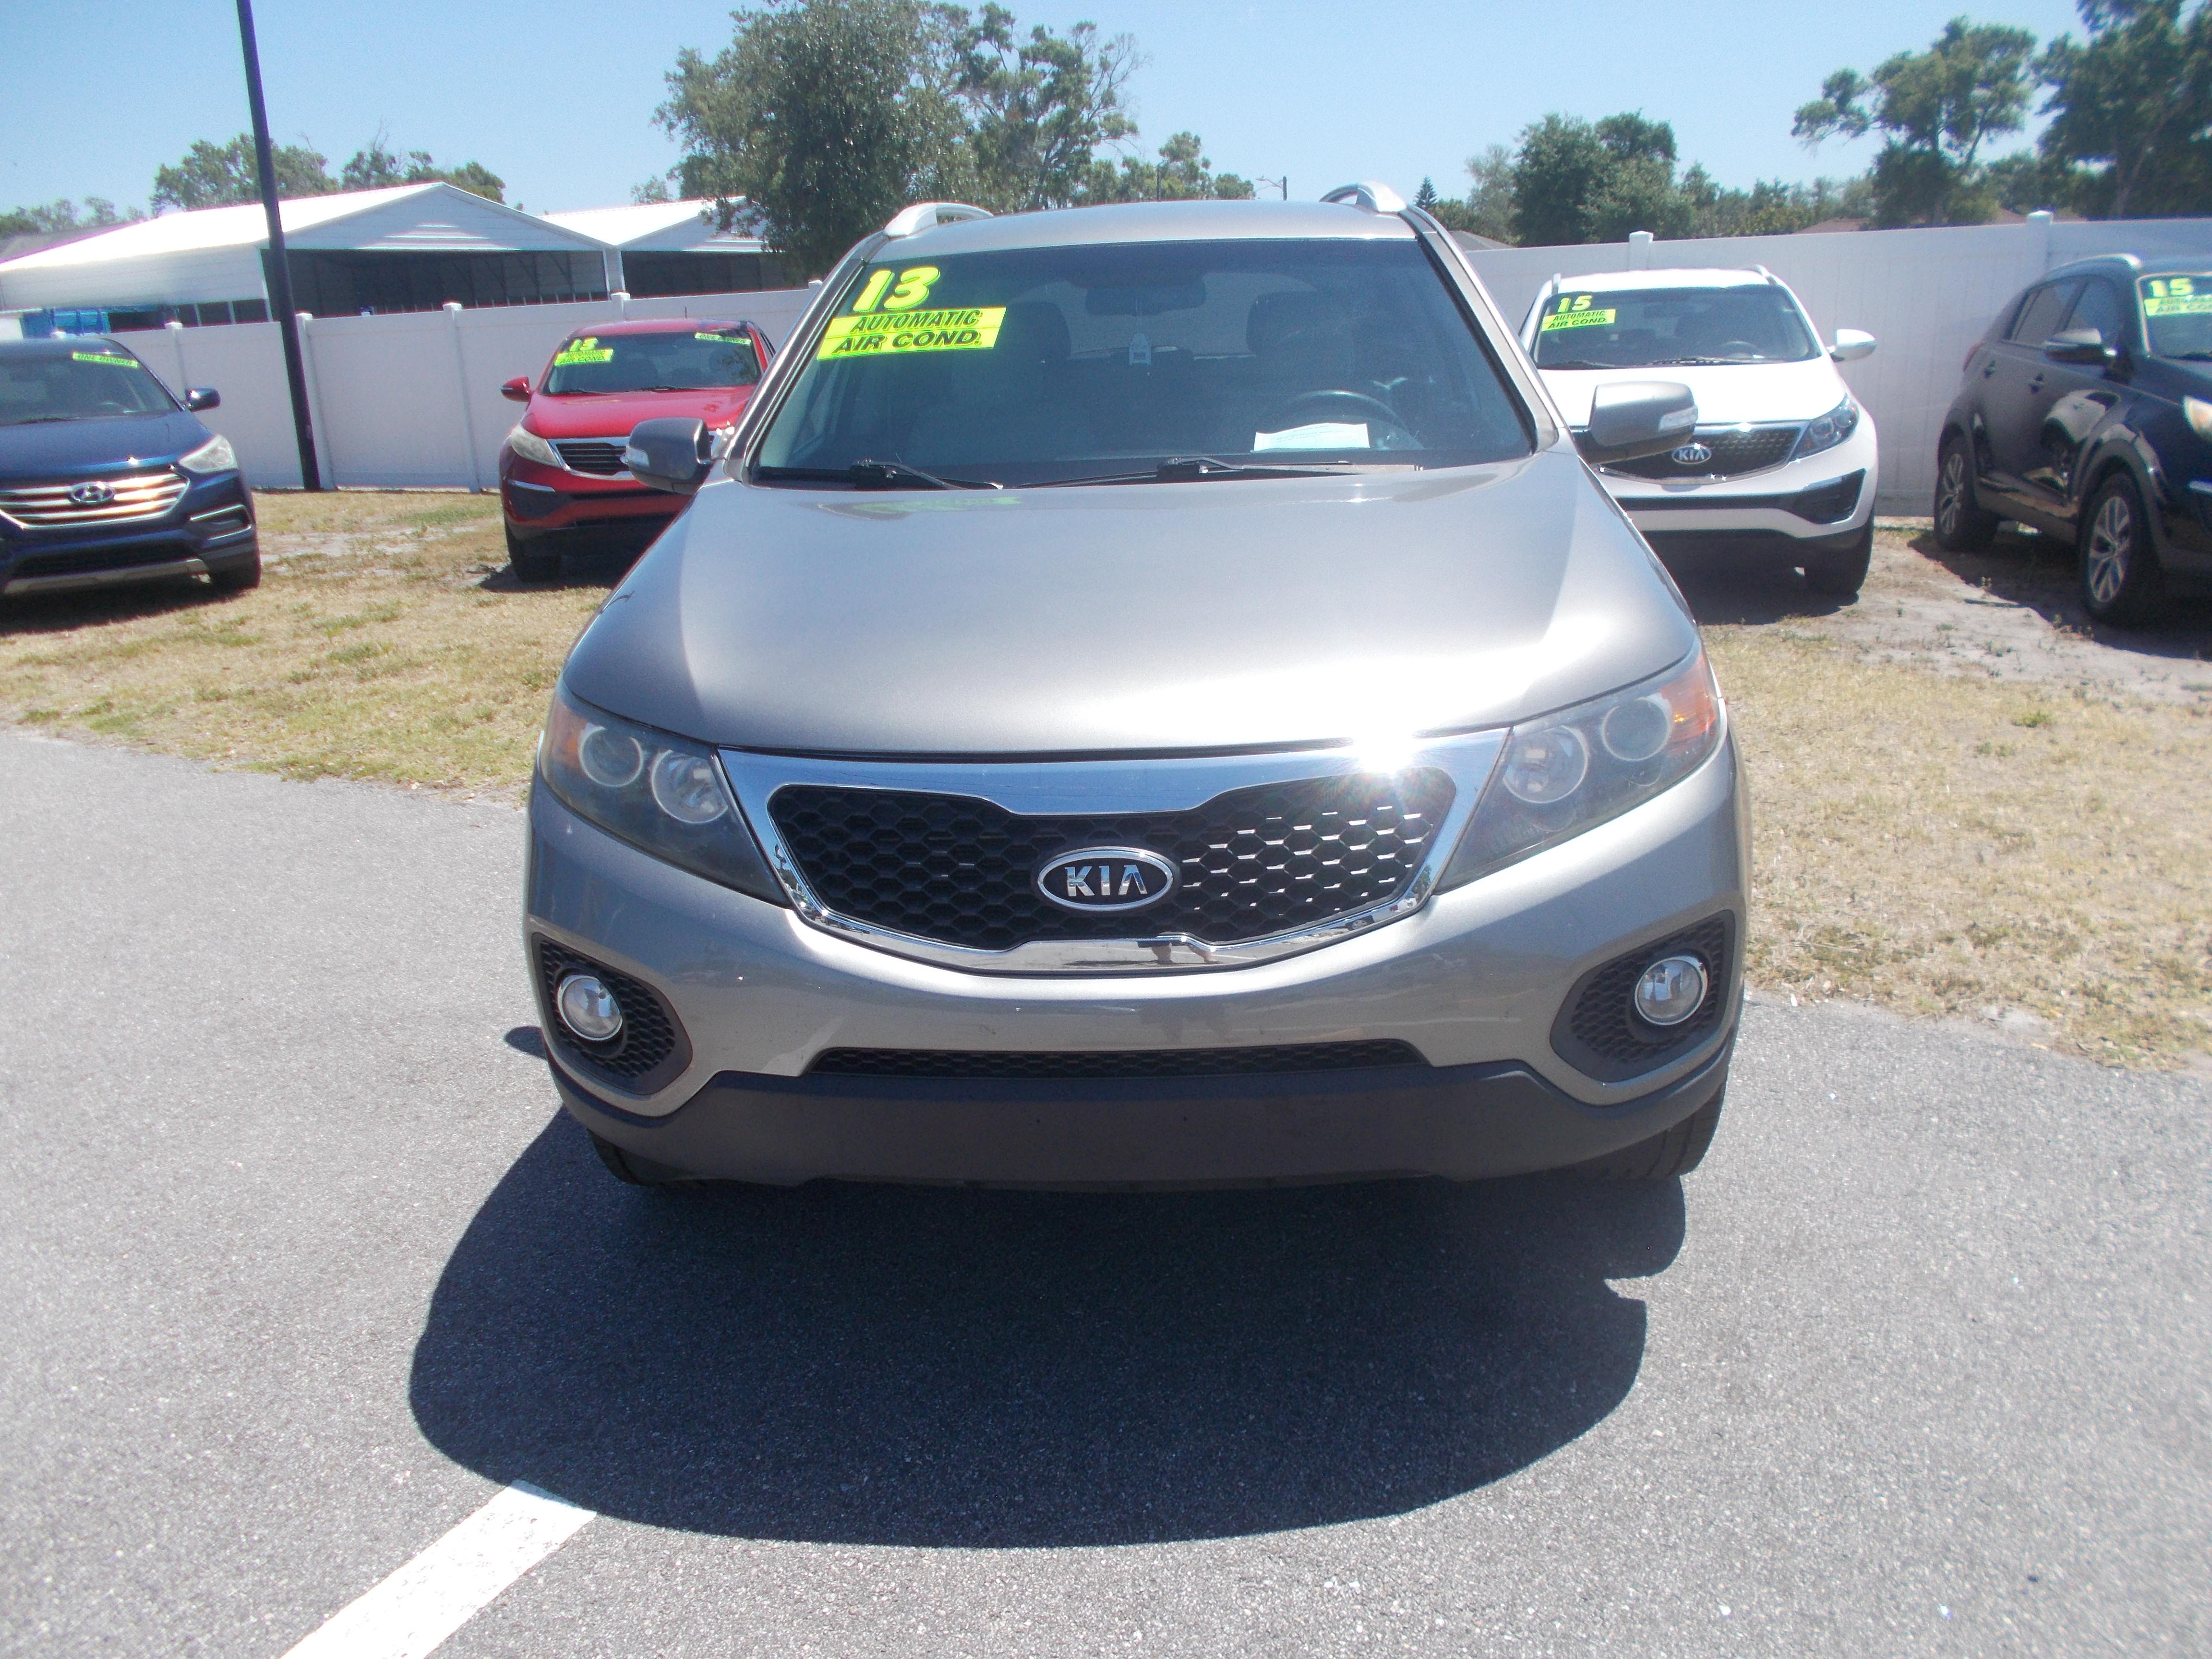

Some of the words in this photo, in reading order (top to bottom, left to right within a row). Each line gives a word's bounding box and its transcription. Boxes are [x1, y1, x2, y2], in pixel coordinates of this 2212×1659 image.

[853, 266, 940, 312] 13
[2150, 277, 2194, 297] 15
[1557, 295, 1593, 313] 15
[850, 309, 983, 334] AUTOMATIC
[1547, 321, 1569, 329] AIR
[1552, 310, 1605, 321] AUTOMATIC
[831, 334, 888, 356] AIR
[892, 329, 981, 349] COND.
[1679, 449, 1705, 461] KIA
[1064, 865, 1148, 897] KIA
